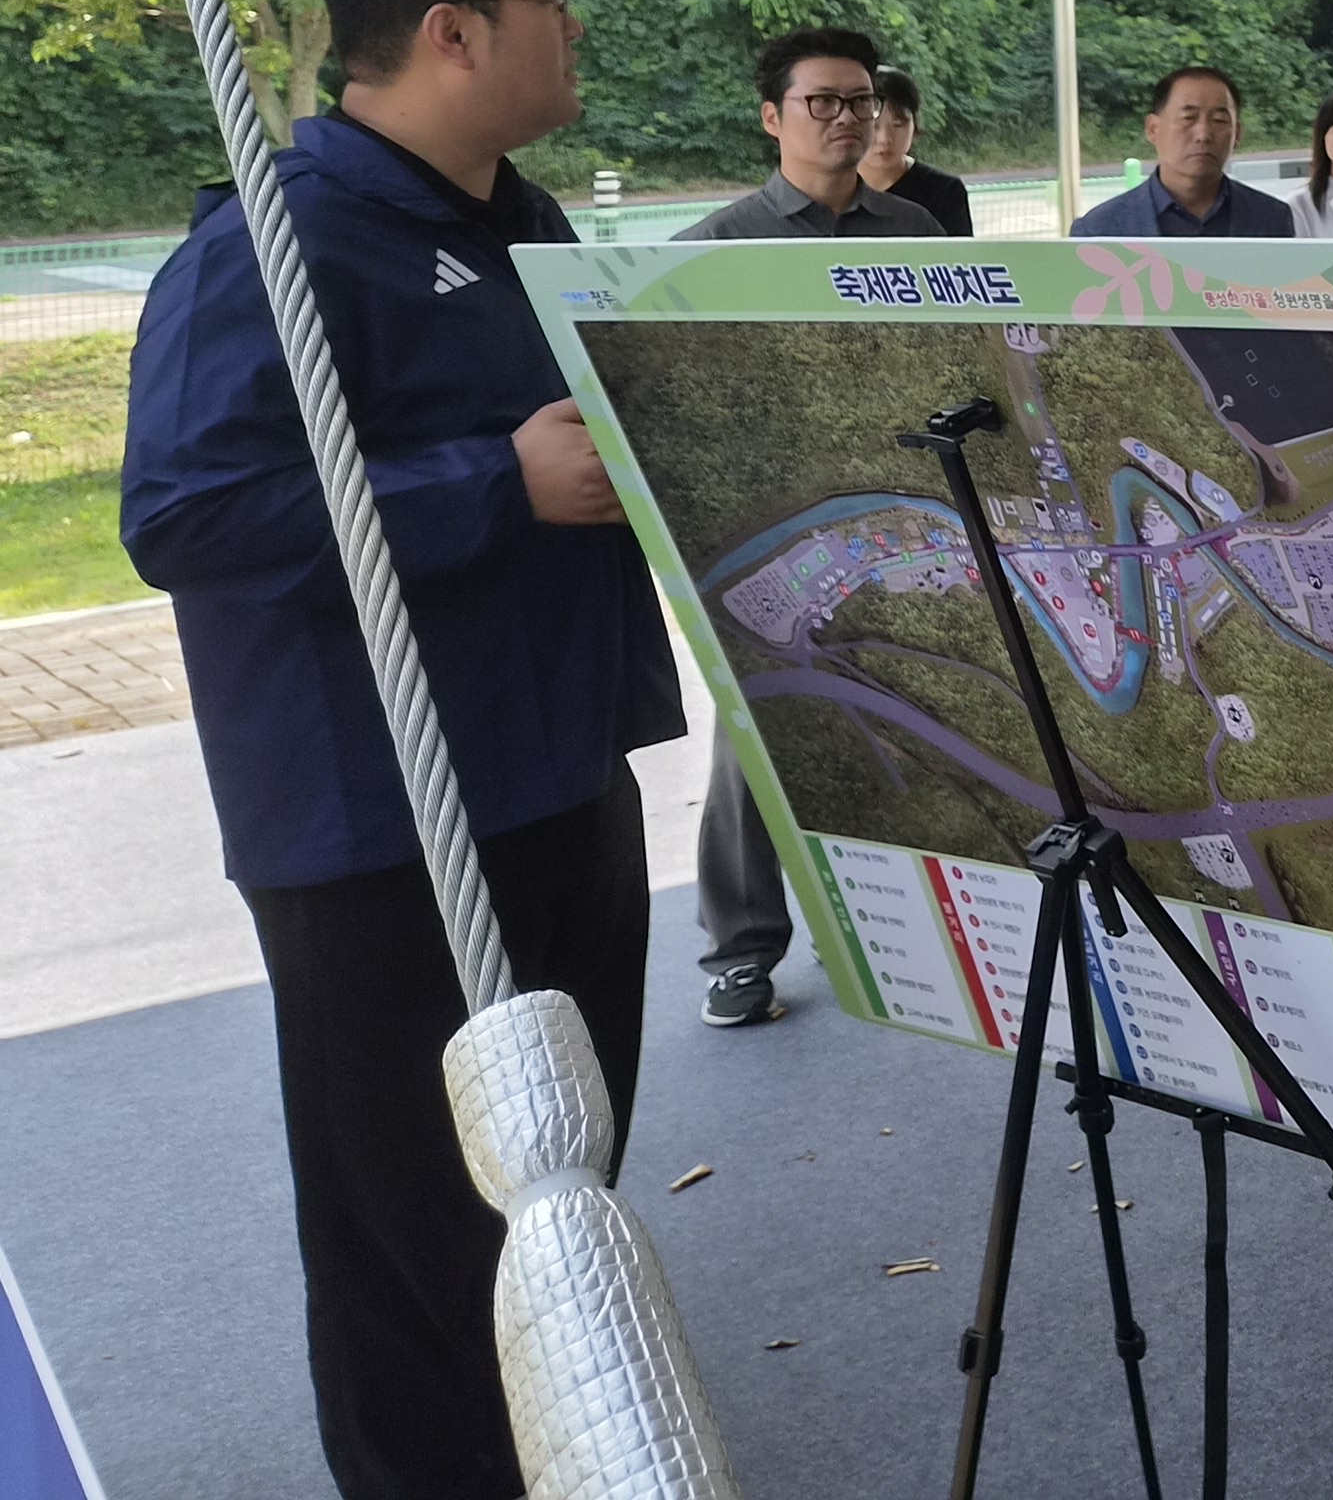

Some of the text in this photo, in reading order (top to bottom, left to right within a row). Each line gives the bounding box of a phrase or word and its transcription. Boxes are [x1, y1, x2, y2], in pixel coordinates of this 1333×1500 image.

[830, 265, 1022, 305] 축제장 배치도
[1204, 289, 1239, 308] 풍성한
[1242, 292, 1272, 309] 가을,
